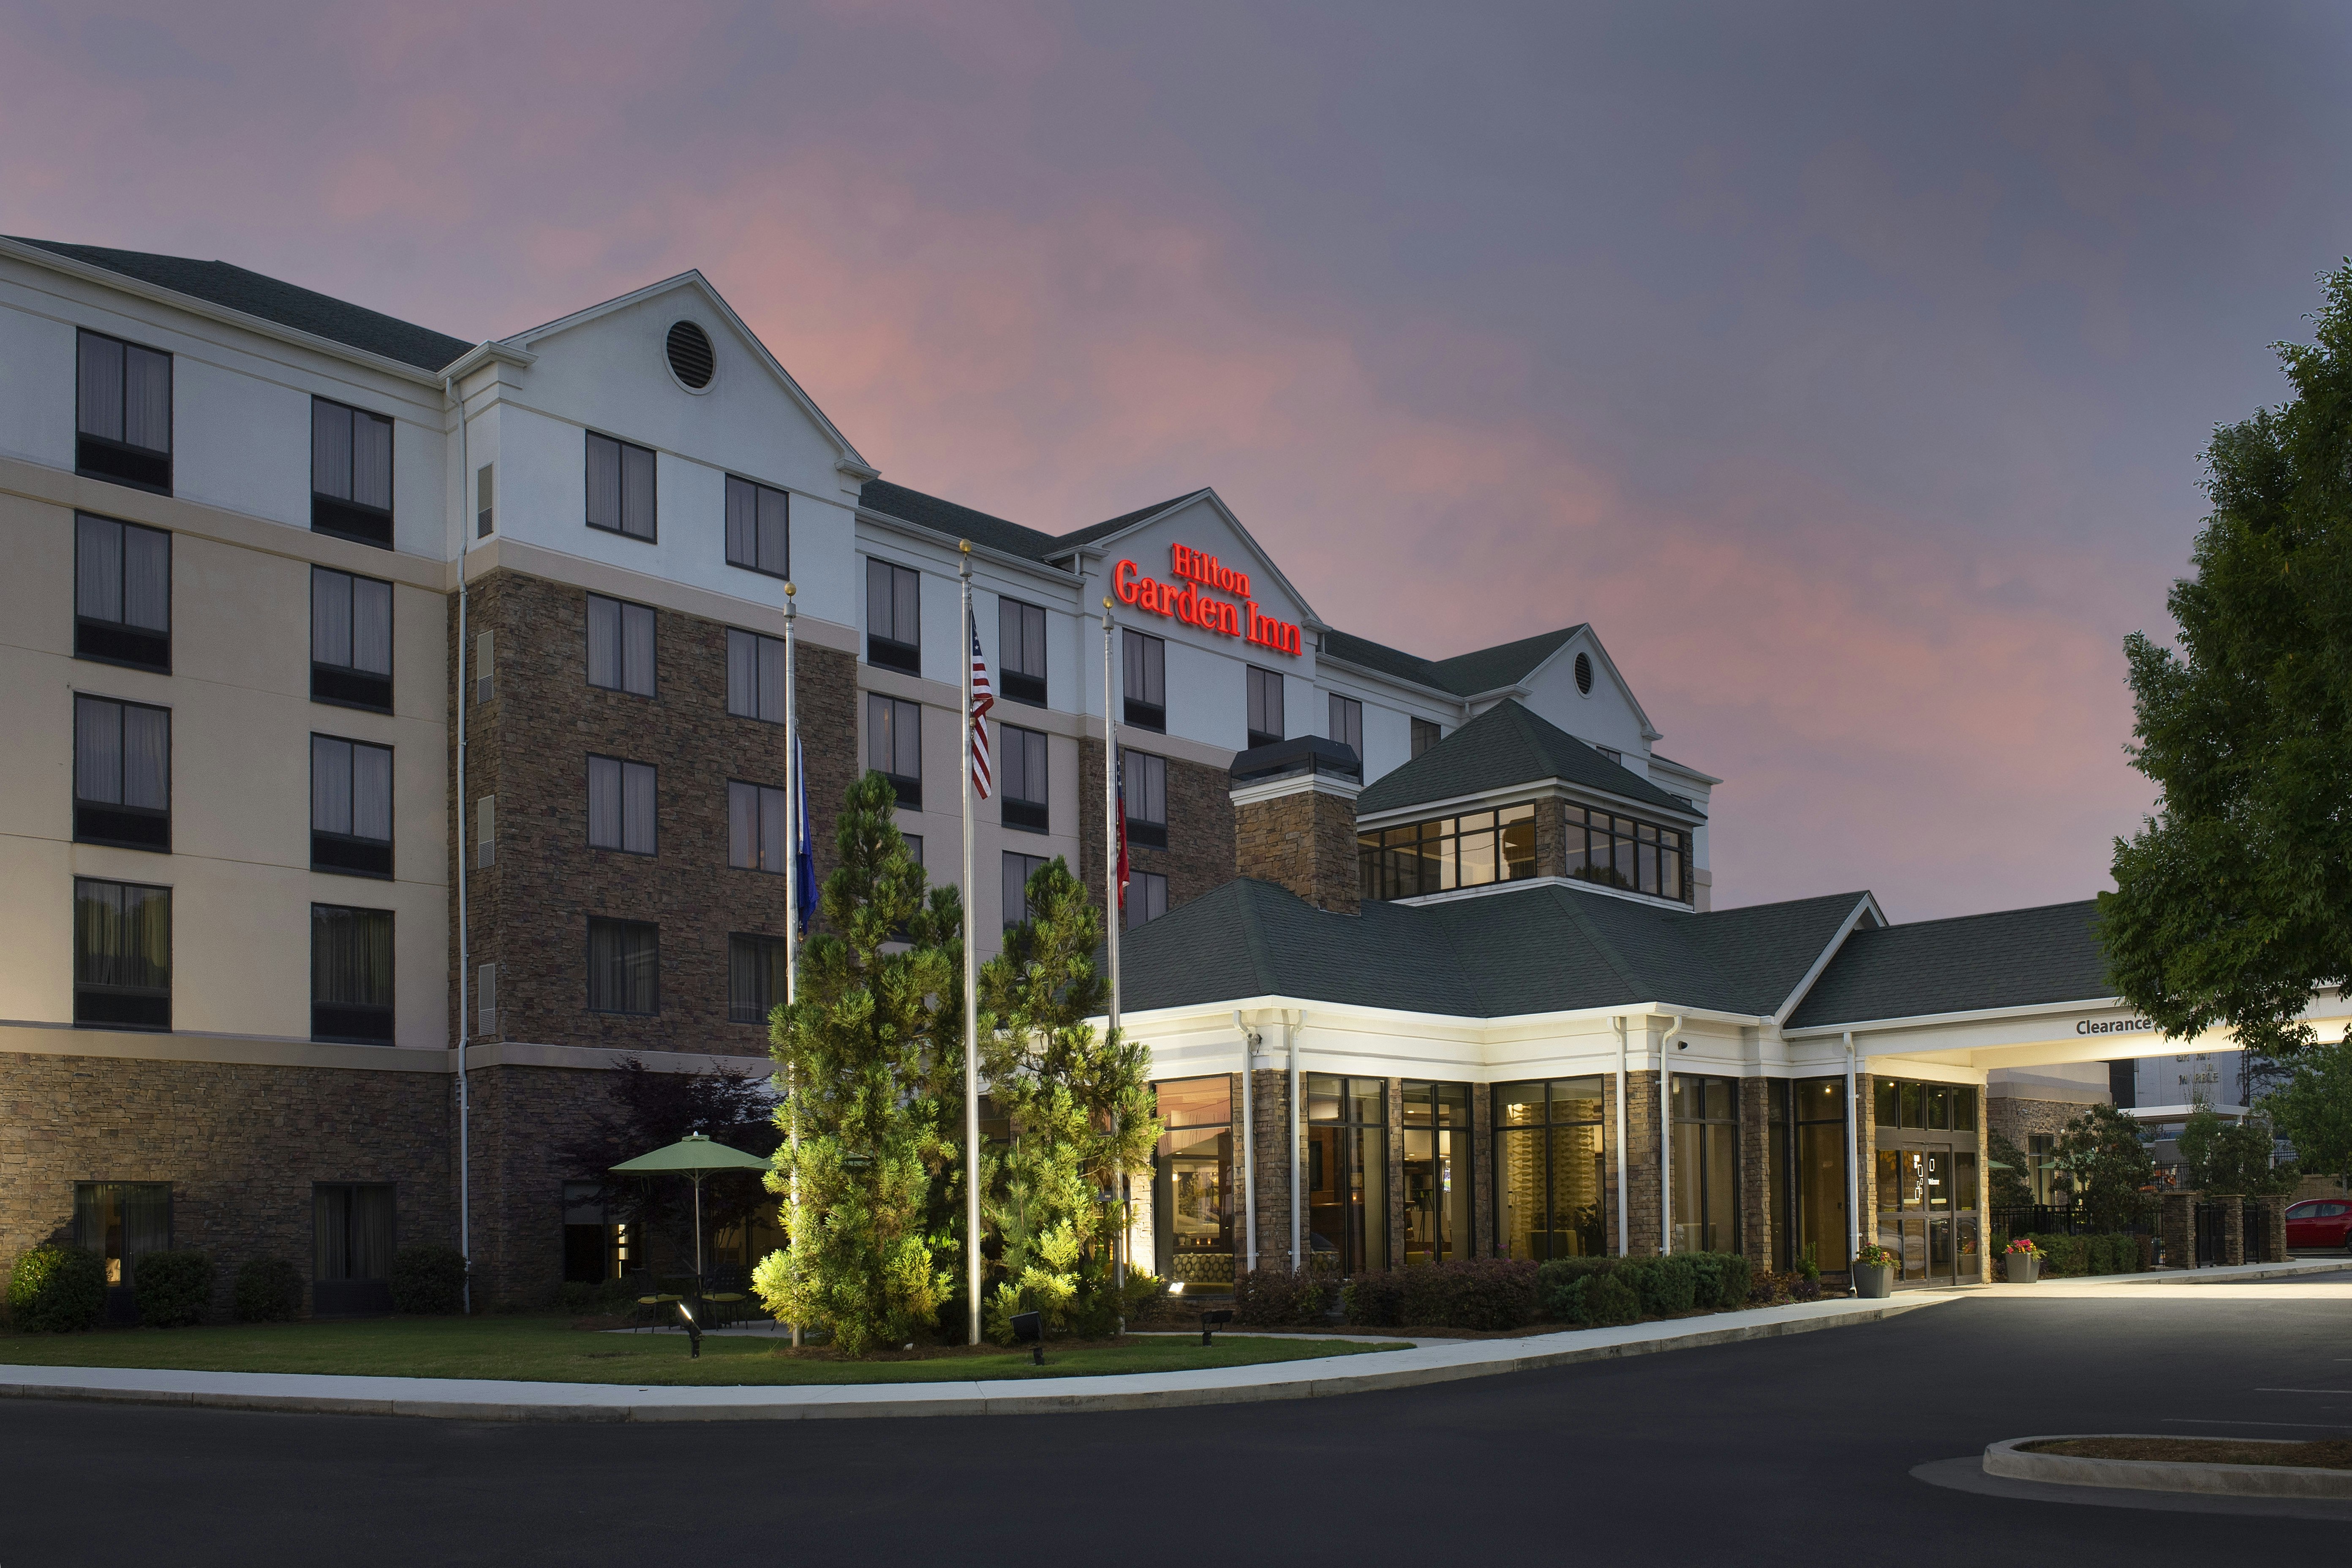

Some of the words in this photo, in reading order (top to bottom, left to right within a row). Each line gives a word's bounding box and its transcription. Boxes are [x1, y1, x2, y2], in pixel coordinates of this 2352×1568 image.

[1172, 542, 1251, 598] Hilton
[1114, 559, 1241, 637] Garden
[1246, 600, 1302, 656] Inn
[2076, 1018, 2151, 1035] Clearance
